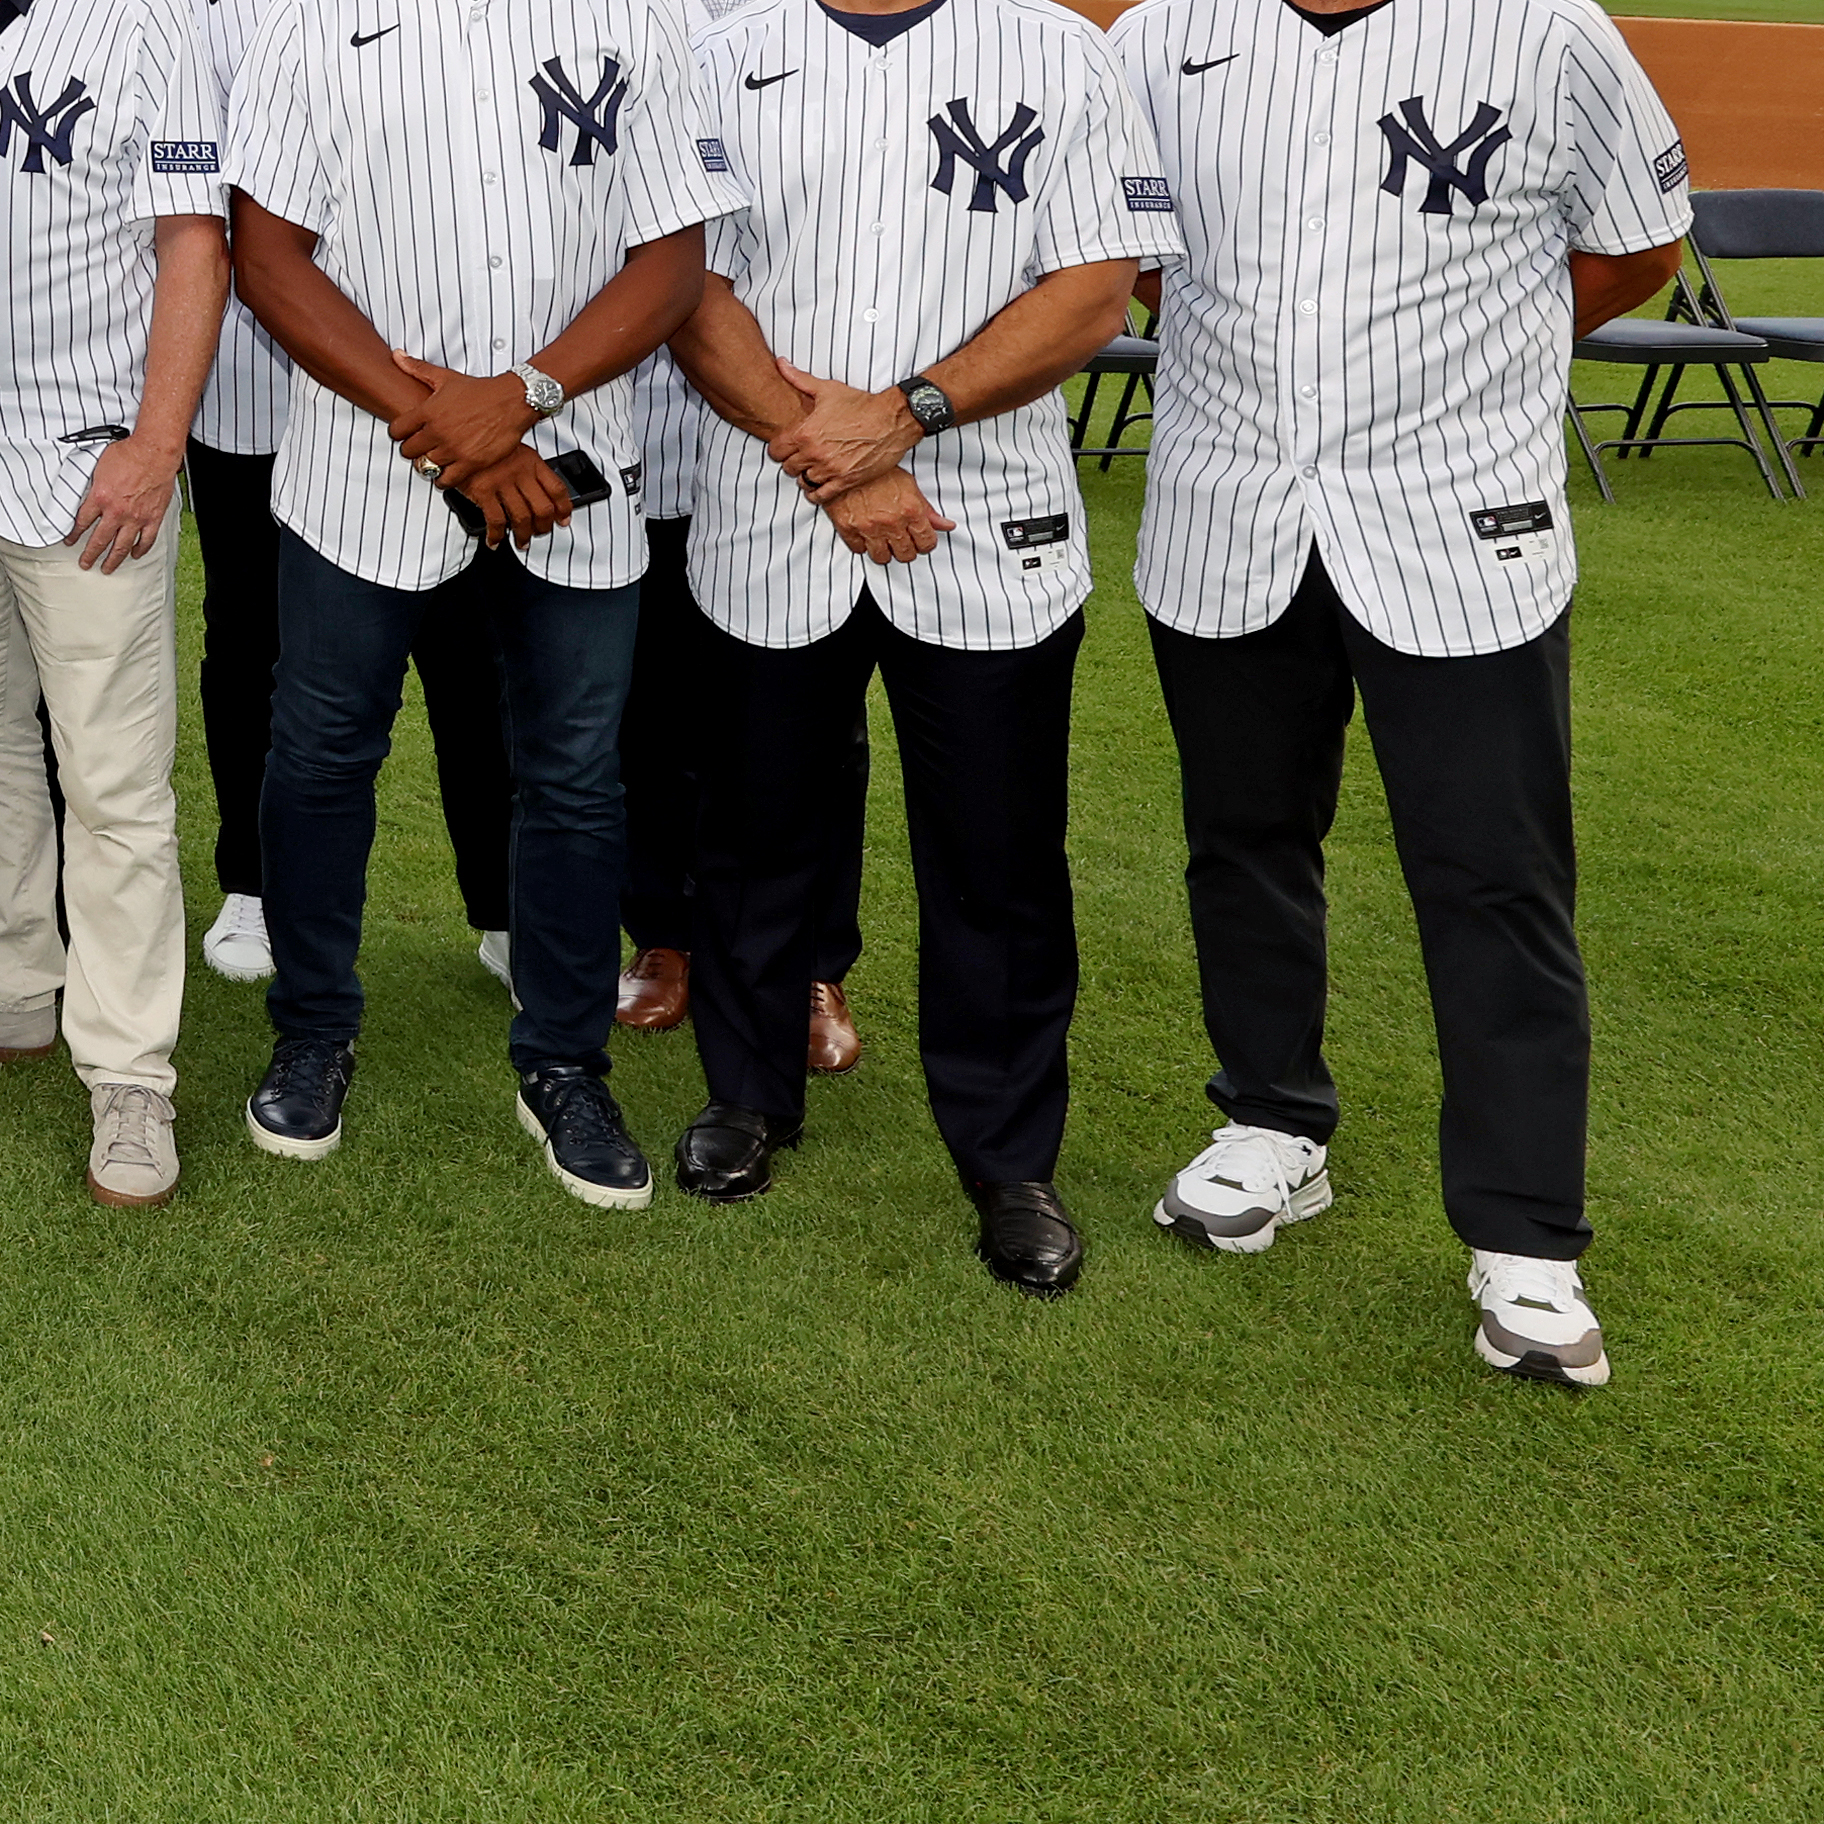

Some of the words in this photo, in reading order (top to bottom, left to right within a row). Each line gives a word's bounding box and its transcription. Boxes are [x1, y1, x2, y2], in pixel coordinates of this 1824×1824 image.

[528, 56, 629, 167] NY
[154, 142, 215, 160] STARR
[927, 98, 1046, 214] NY
[1377, 94, 1513, 215] NY
[156, 163, 218, 172] INSURANCE
[1125, 179, 1167, 196] STARR
[1130, 201, 1172, 209] INSURANCE
